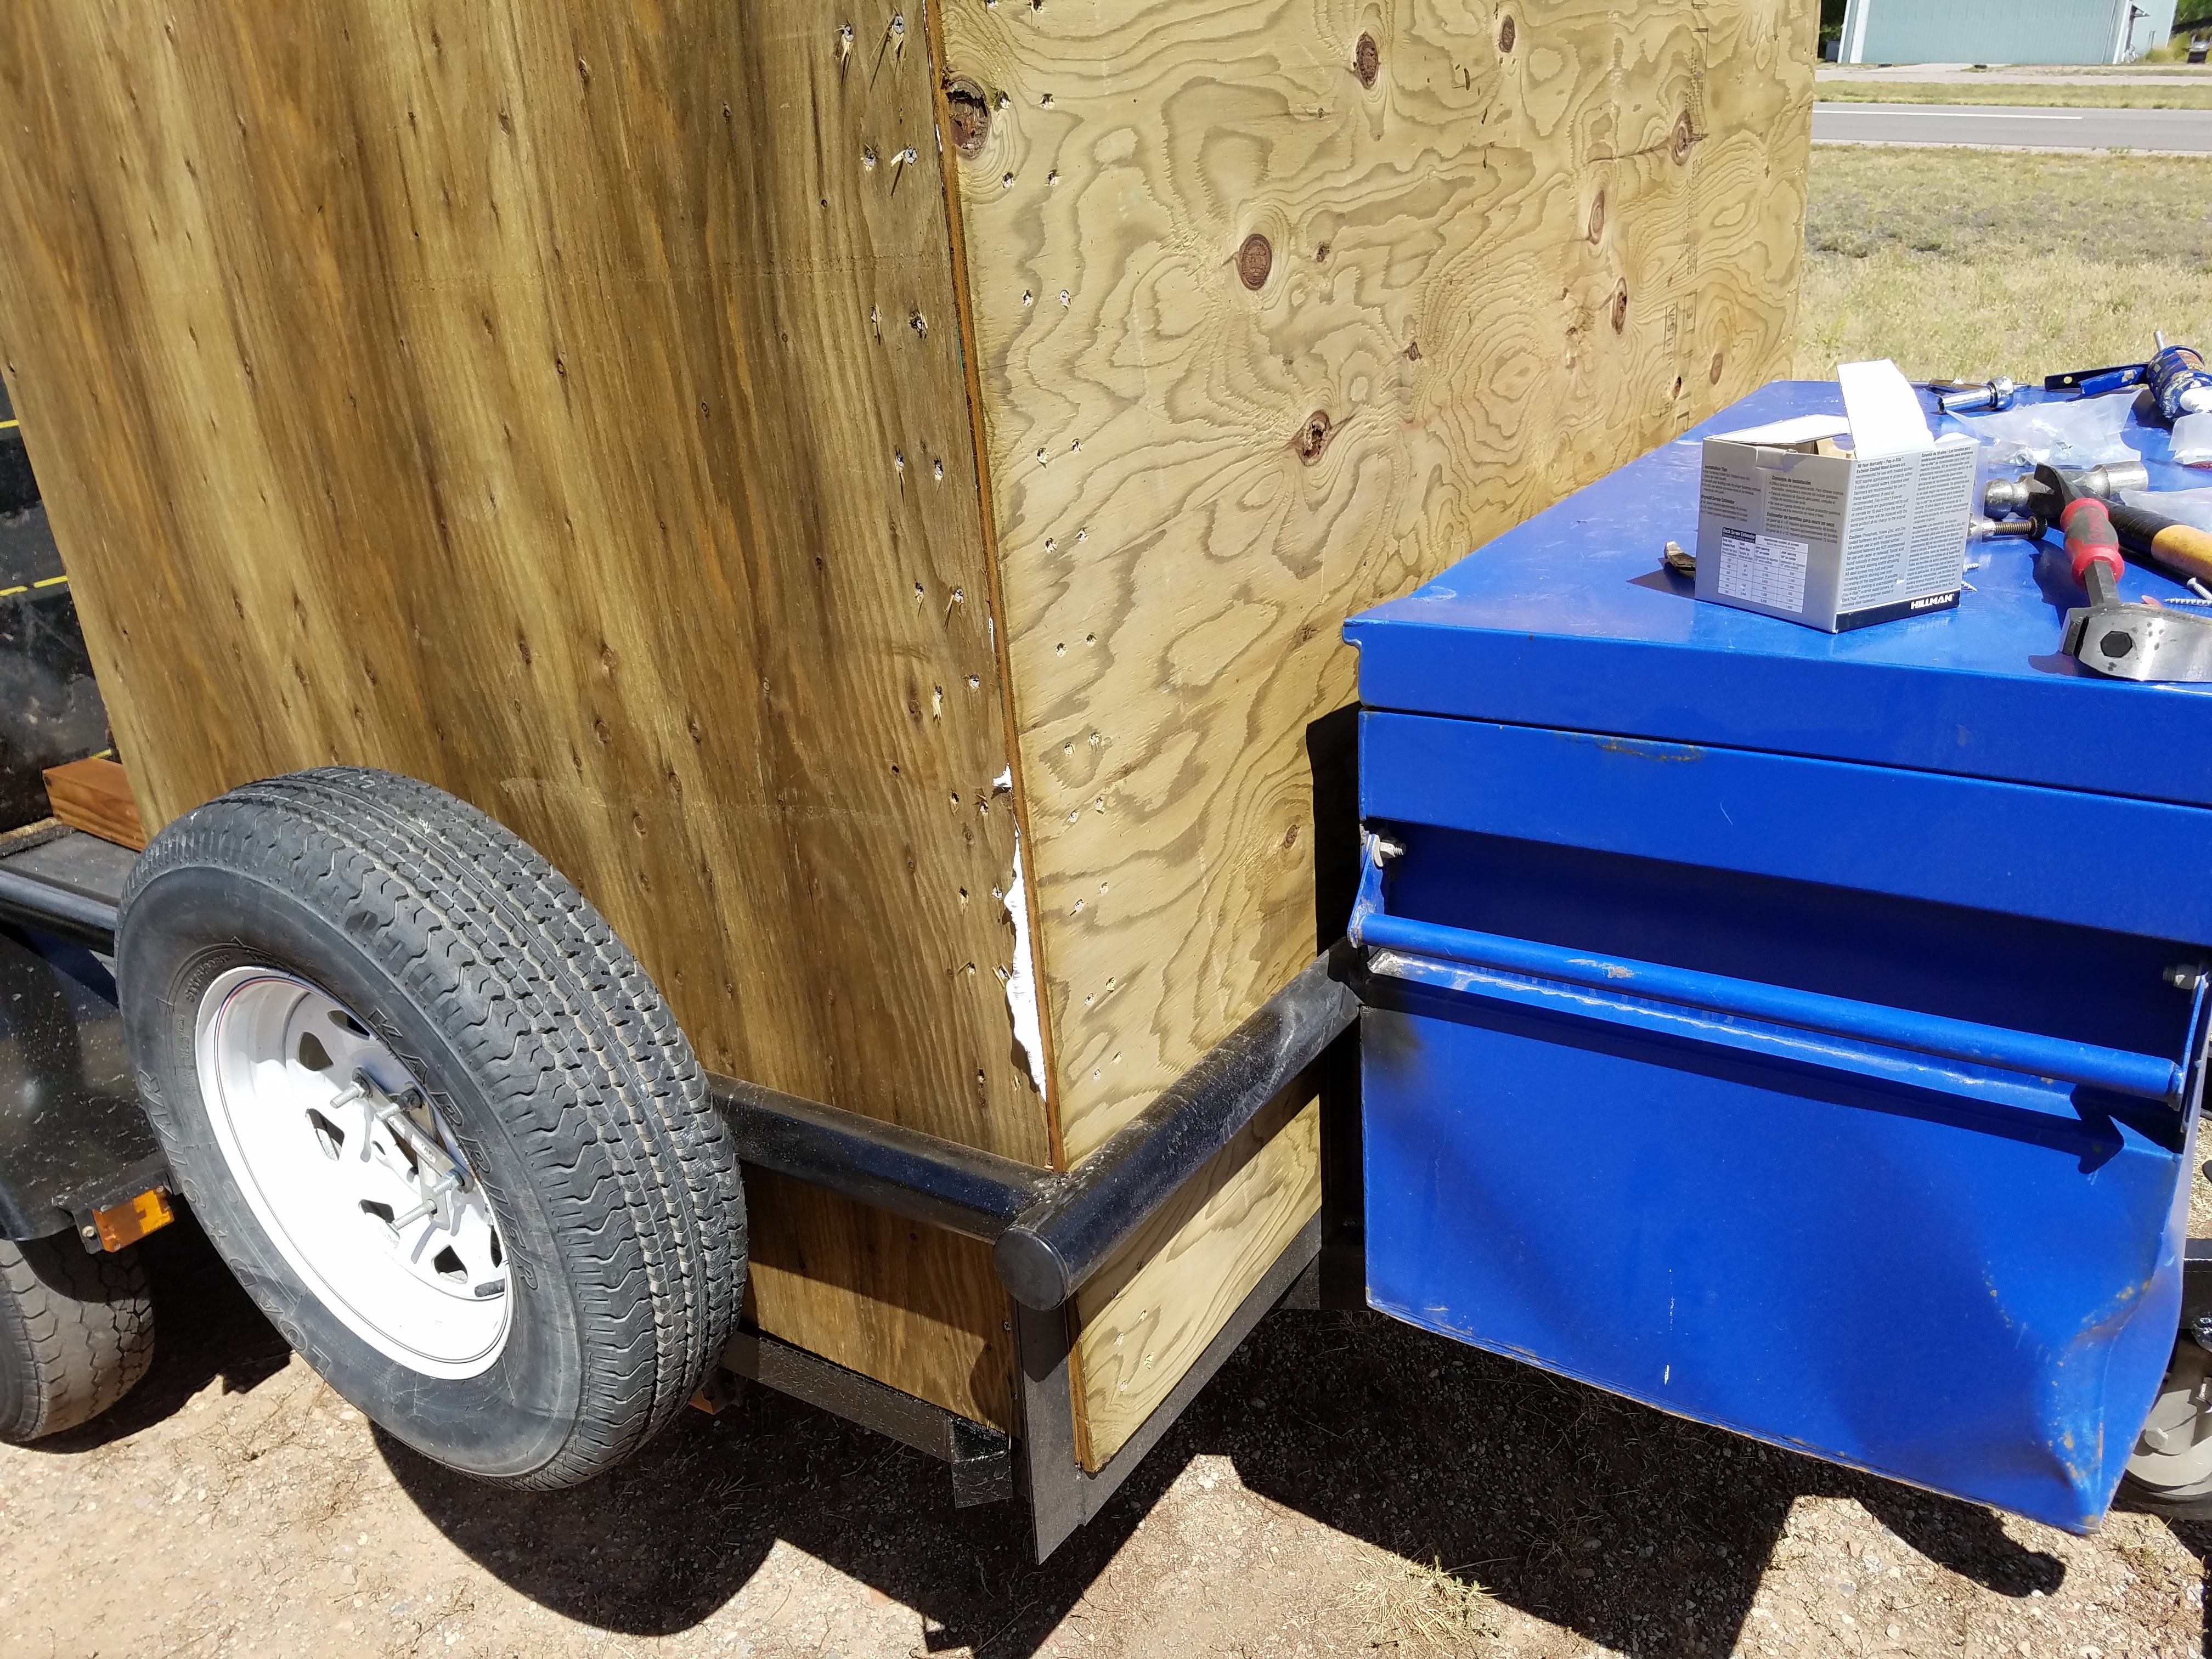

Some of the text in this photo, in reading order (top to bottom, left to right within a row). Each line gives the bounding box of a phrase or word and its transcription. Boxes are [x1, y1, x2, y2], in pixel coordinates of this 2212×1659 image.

[1911, 595, 1953, 610] HILLMAN
[140, 1069, 332, 1374] LOAD STAR
[367, 1008, 539, 1290] KARRIER
